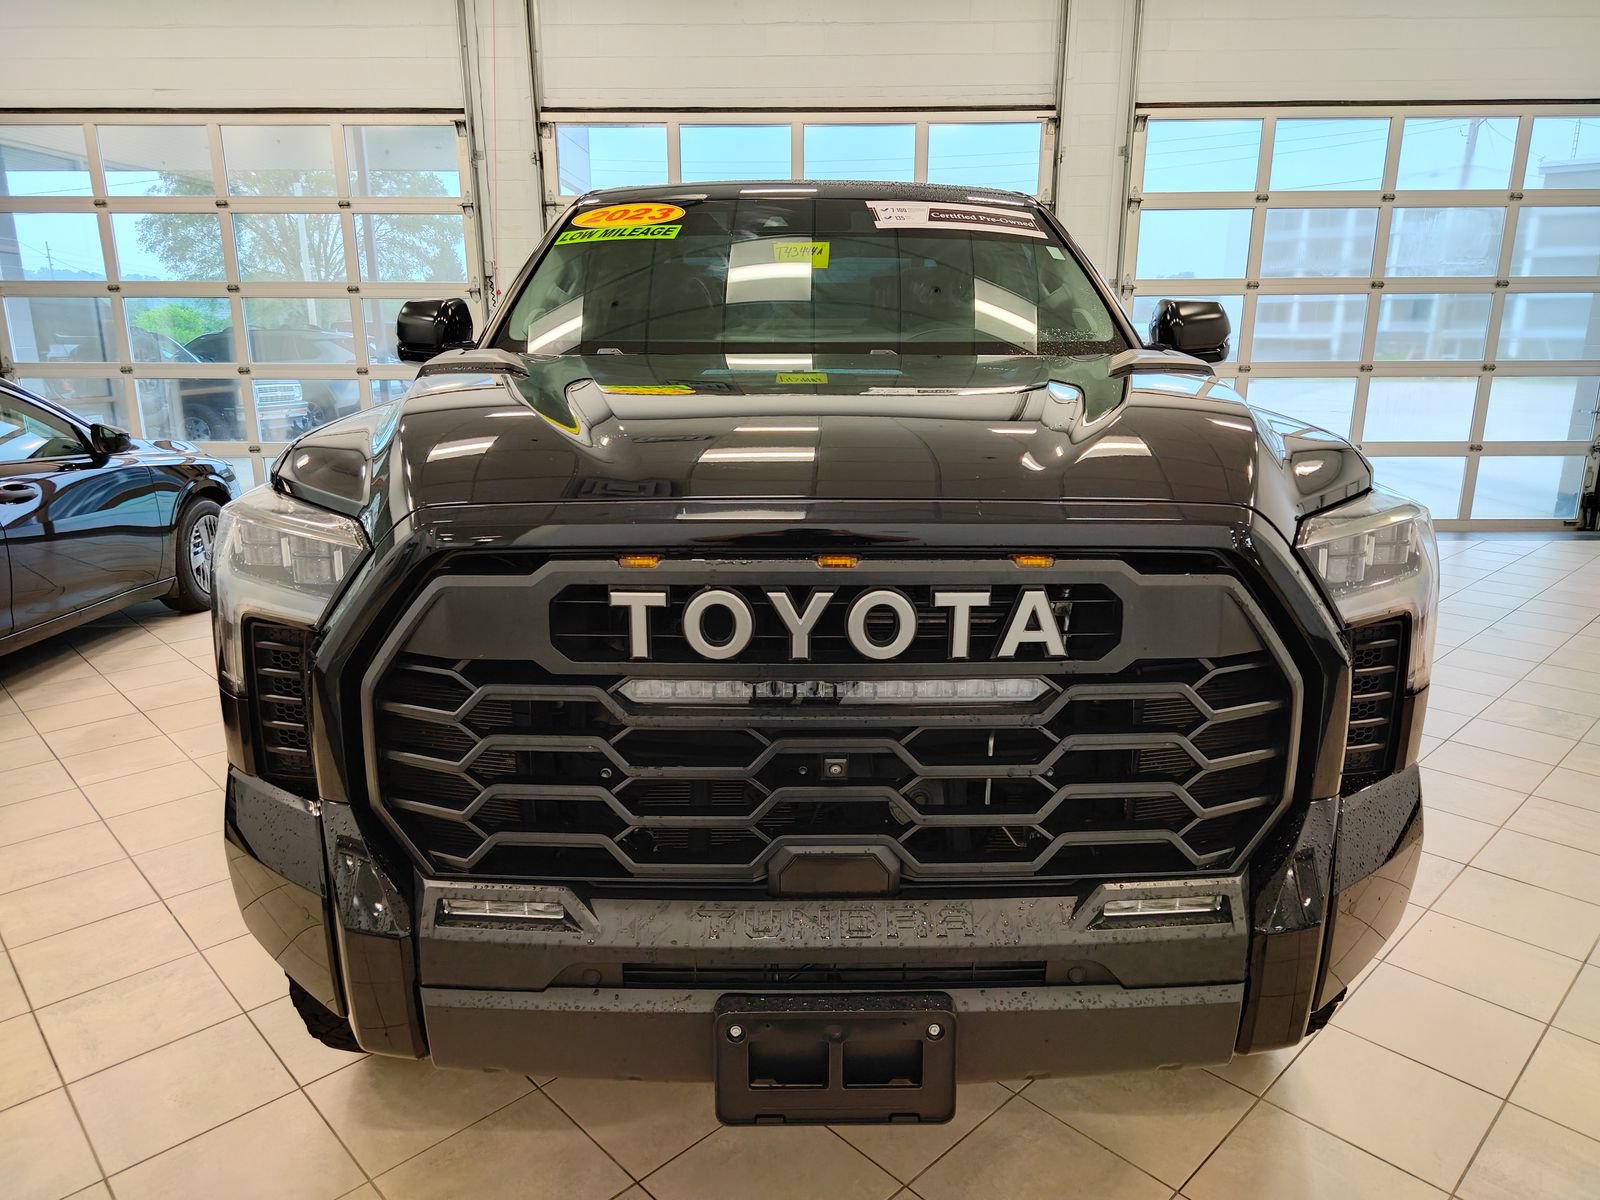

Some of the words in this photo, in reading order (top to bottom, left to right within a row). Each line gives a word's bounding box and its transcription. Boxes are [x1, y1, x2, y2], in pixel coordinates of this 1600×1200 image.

[580, 207, 675, 225] 2023
[930, 211, 977, 221] Certified
[979, 214, 1035, 228] Pre-Owned
[558, 229, 599, 242] LOW
[598, 226, 677, 239] MILEAGE
[608, 589, 1068, 661] TOYOTA
[695, 908, 977, 940] TUNDRA
